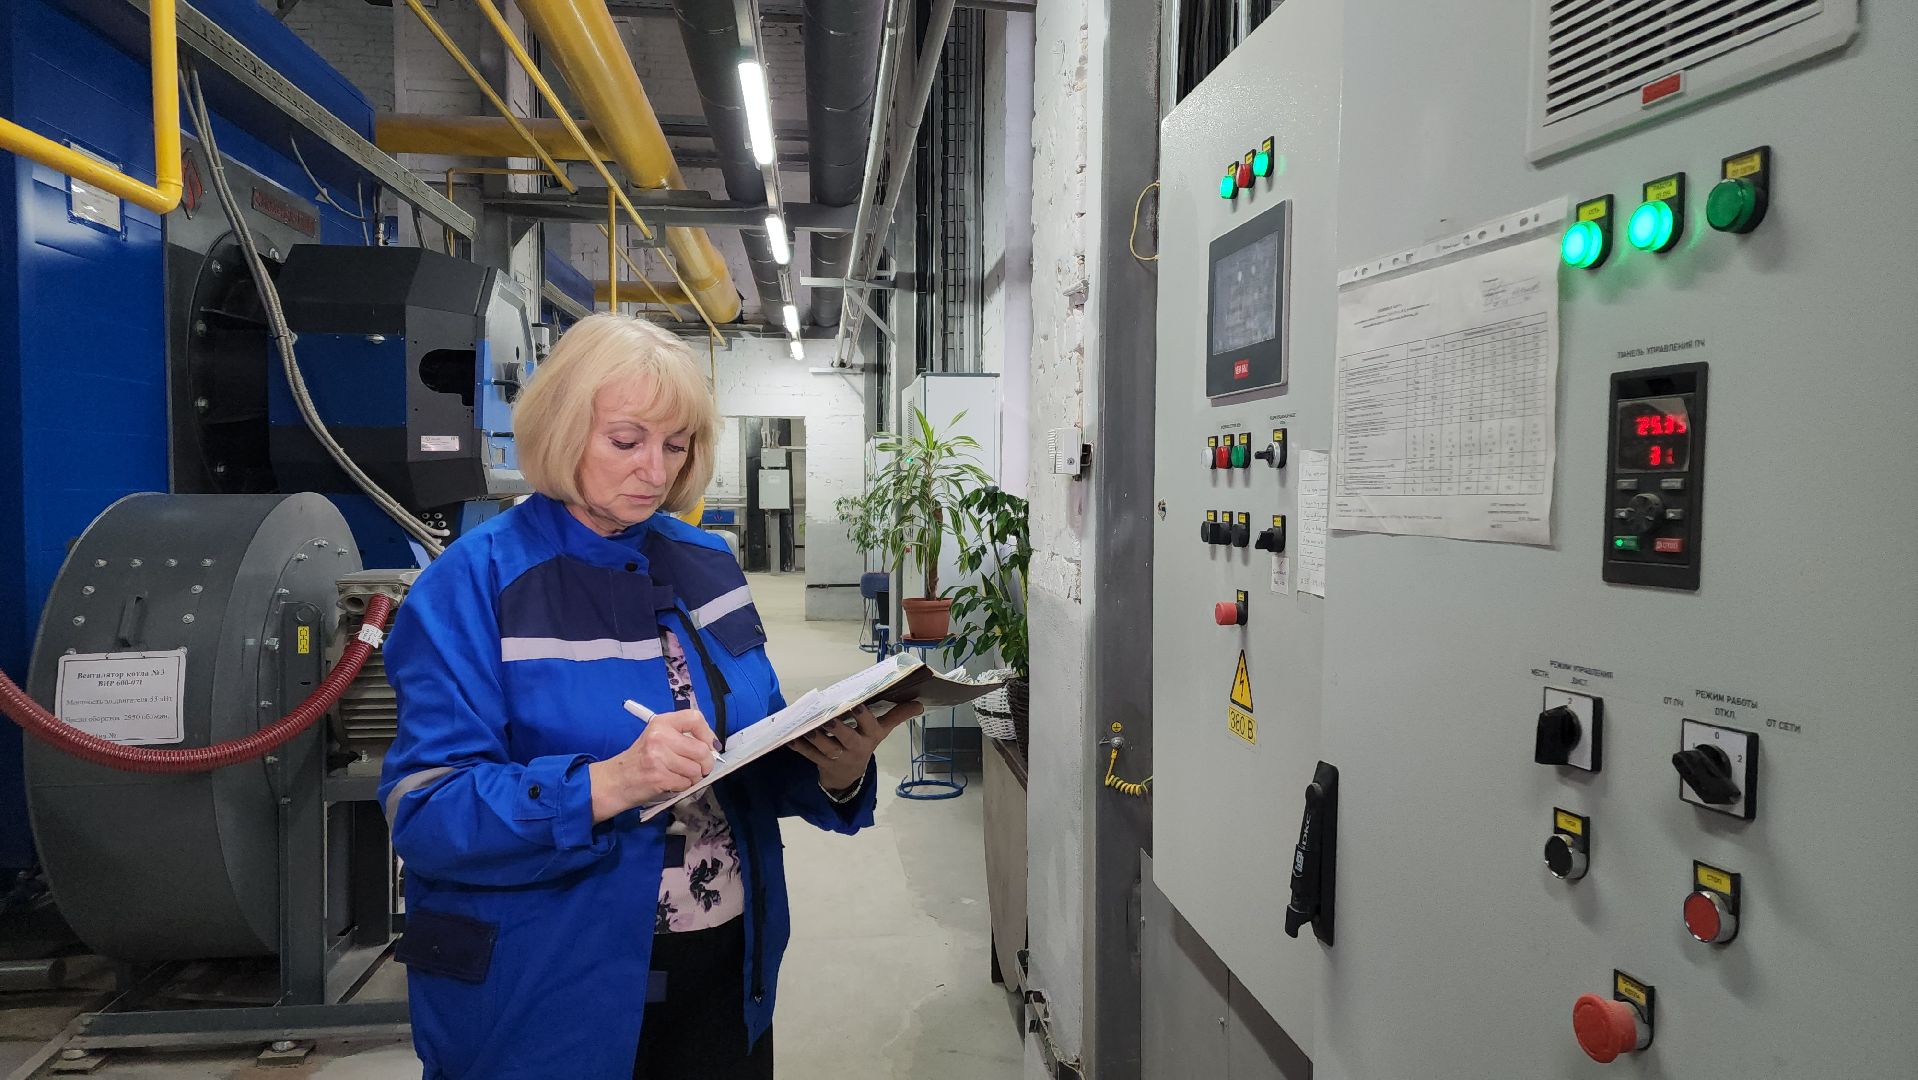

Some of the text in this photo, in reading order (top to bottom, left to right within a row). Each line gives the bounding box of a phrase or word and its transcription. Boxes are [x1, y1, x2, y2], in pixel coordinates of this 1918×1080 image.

[1617, 348, 1645, 359] ПАНЕЛЬ
[1646, 340, 1693, 355] УПРАВЛЕНИЯ
[77, 671, 123, 680] Вентилятор
[126, 671, 149, 679] котла
[1567, 697, 1573, 705] 2
[1663, 696, 1672, 704] ОТ
[1695, 689, 1759, 709] РЕЖИМ РАБОТЫ
[1230, 711, 1254, 740] 380 В
[1766, 718, 1801, 734] ОТ СЕТИ
[1714, 731, 1720, 740] 0
[1737, 755, 1743, 764] 2
[1301, 813, 1312, 846] DKC
